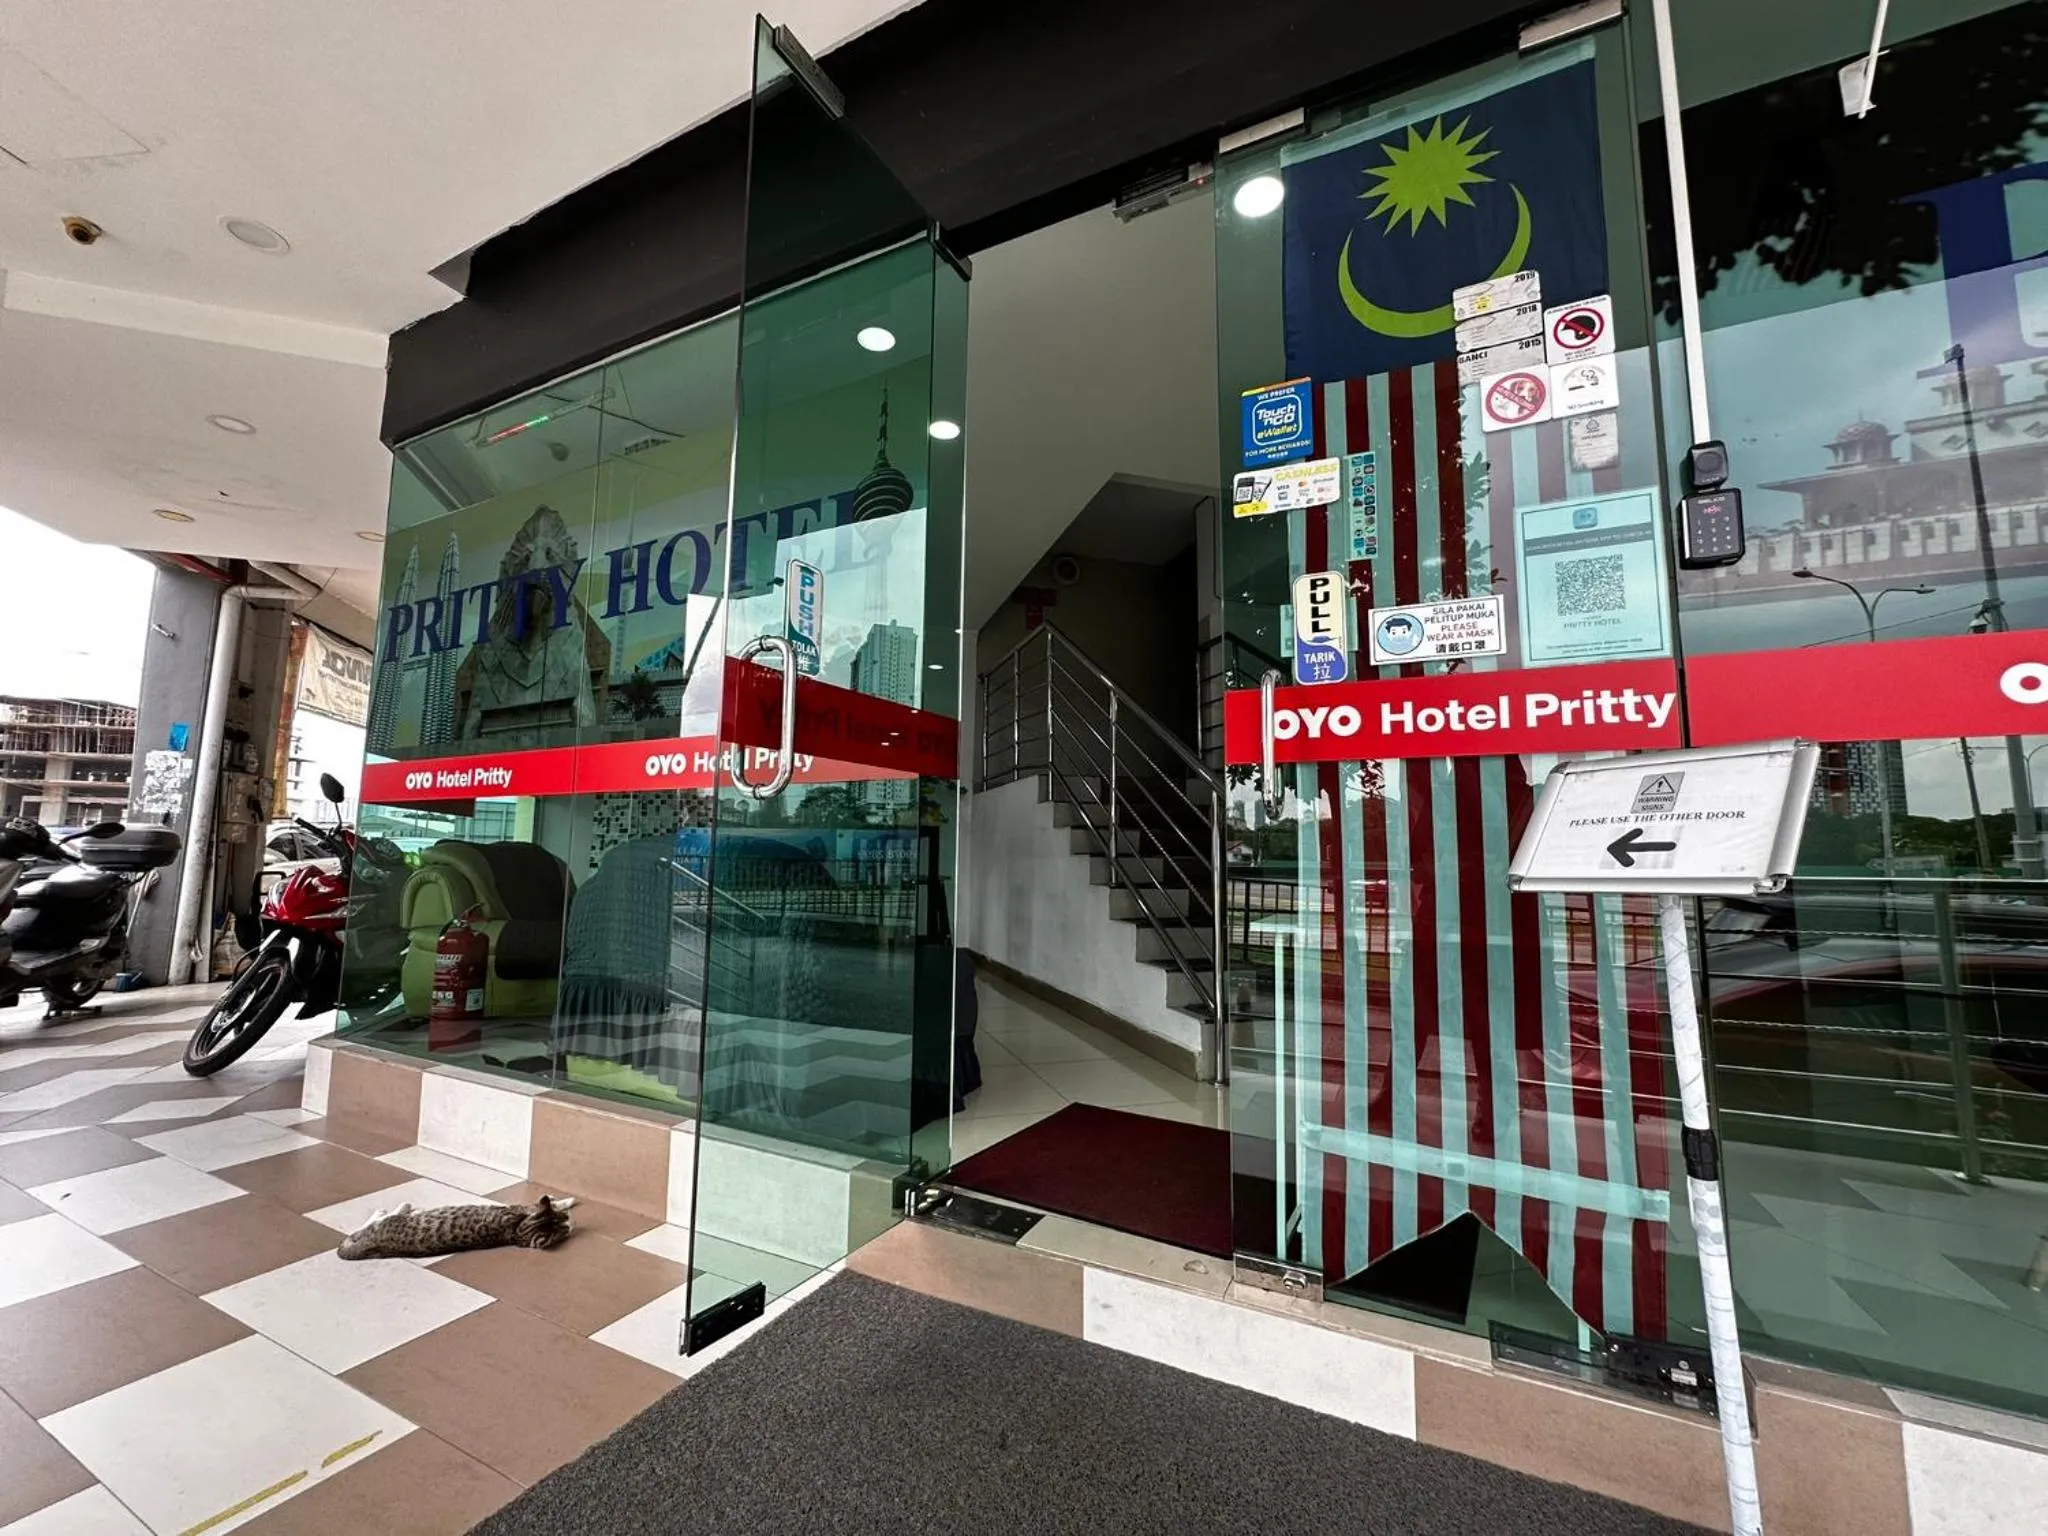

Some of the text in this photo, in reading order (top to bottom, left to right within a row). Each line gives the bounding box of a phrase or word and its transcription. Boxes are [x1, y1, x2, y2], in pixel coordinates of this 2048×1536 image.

[1515, 271, 1536, 283] 2019
[1516, 305, 1537, 316] 2018
[1518, 338, 1541, 350] 2015
[1270, 386, 1296, 398] PREFER
[1256, 403, 1296, 420] Touch
[1259, 446, 1277, 455] MORE
[383, 488, 888, 663] PRITTY HOTEL
[798, 566, 815, 636] PUSH
[1310, 577, 1331, 634] PULL
[1432, 602, 1486, 615] SILA PAKAI
[1424, 609, 1495, 624] PELITUP MUKA
[1441, 622, 1478, 632] PLEASE
[1427, 628, 1495, 642] WEAR A MASK
[1304, 651, 1336, 664] TARIK
[1313, 663, 1331, 680] 拉
[1274, 687, 1677, 741] OYO Hotel Pritty
[645, 753, 687, 776] OYO
[405, 767, 513, 790] OYO Hotel Pritty
[1641, 803, 1664, 811] SIGNS
[1569, 817, 1608, 827] PLEASE
[1634, 813, 1657, 822] THE
[1659, 811, 1702, 821] OTHER
[1705, 810, 1746, 820] DOOR
